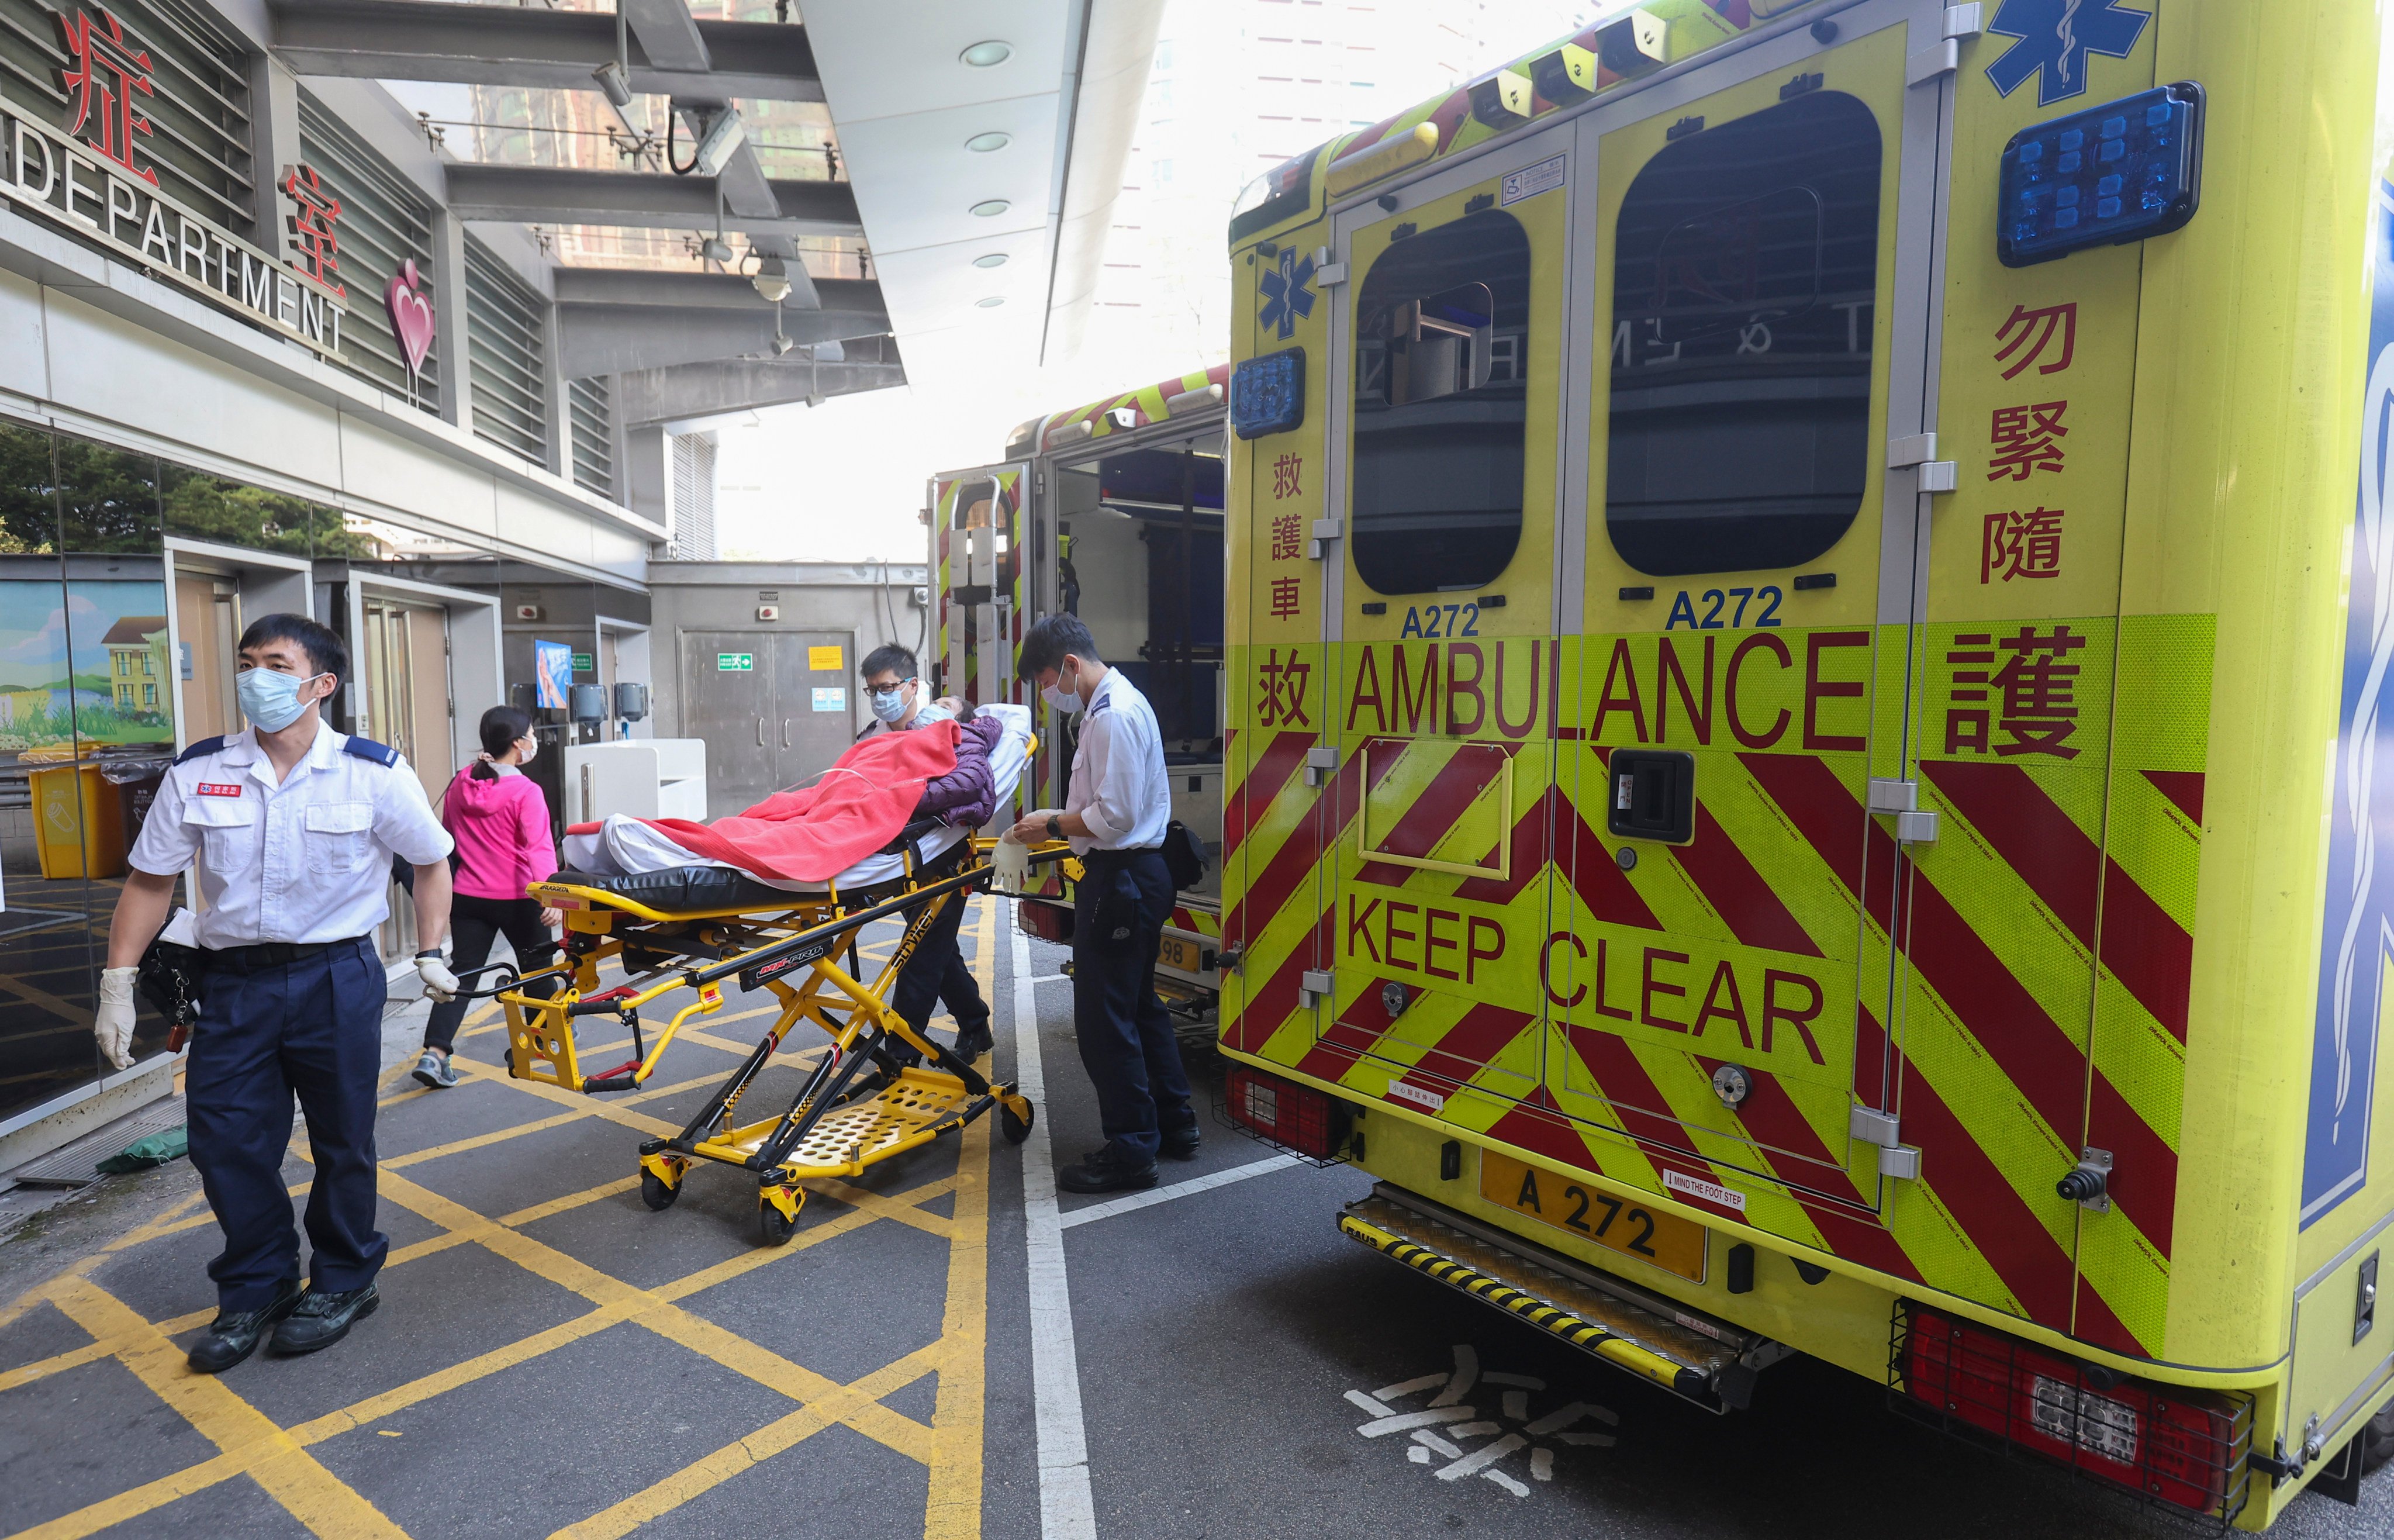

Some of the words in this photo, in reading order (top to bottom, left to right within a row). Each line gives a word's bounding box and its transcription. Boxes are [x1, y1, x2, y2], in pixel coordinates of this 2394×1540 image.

[15, 120, 346, 353] DEPARTMENT
[1980, 302, 2077, 584] 勿緊隨
[1270, 451, 1303, 621] 救護車
[1400, 603, 1479, 639] A272
[1665, 585, 1783, 630] A272
[1257, 648, 1311, 728] 救
[1347, 631, 1870, 752] AMBULANCE
[1944, 626, 2086, 761] 護
[2162, 807, 2182, 827] ORAFOL
[2181, 824, 2198, 841] Europe
[1159, 940, 1183, 965] 98
[1348, 893, 1506, 985] KEEP
[1539, 930, 1826, 1066] CLEAR
[2148, 1025, 2168, 1045] ORAFOL
[2166, 1044, 2183, 1061] Europe
[2016, 1101, 2034, 1120] ORAFOL
[2032, 1119, 2047, 1136] Europe
[2045, 1134, 2058, 1149] GmbH
[2057, 1149, 2072, 1166] TPESC
[1517, 1169, 1541, 1214] A
[1564, 1186, 1655, 1257] 272
[1674, 1176, 1690, 1189] MIND
[1691, 1181, 1704, 1194] THE
[1705, 1186, 1723, 1199] FOOT
[1724, 1192, 1742, 1205] STEP
[2133, 1238, 2153, 1259] ORAFOL
[2151, 1258, 2168, 1275] Europe
